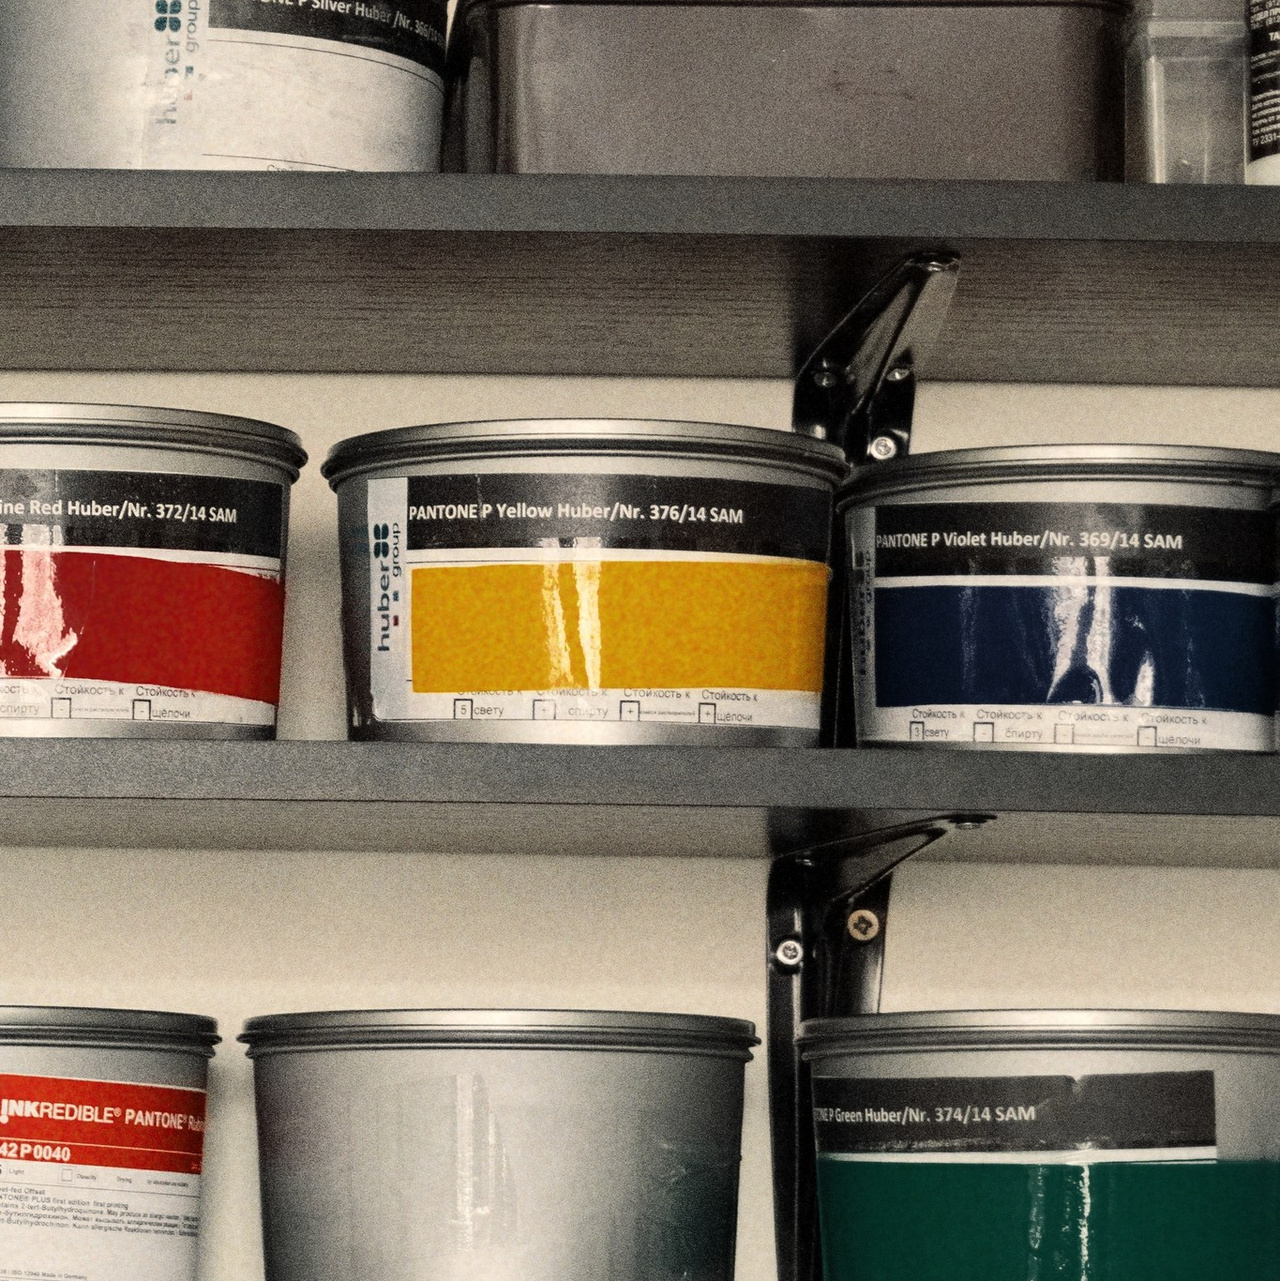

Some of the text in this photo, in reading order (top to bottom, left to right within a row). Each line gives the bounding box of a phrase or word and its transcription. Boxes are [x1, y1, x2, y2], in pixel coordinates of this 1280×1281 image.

[355, 3, 391, 23] Huber
[29, 500, 62, 516] Red
[67, 501, 151, 519] Huber/Nr.
[156, 504, 206, 521] 372/14
[209, 507, 237, 523] SAM
[408, 503, 706, 522] PANTONE P Yellow 376/14
[943, 531, 1139, 549] Violet 369/14
[835, 1106, 1035, 1126] Green Huber/Nr. 374/14 SAM
